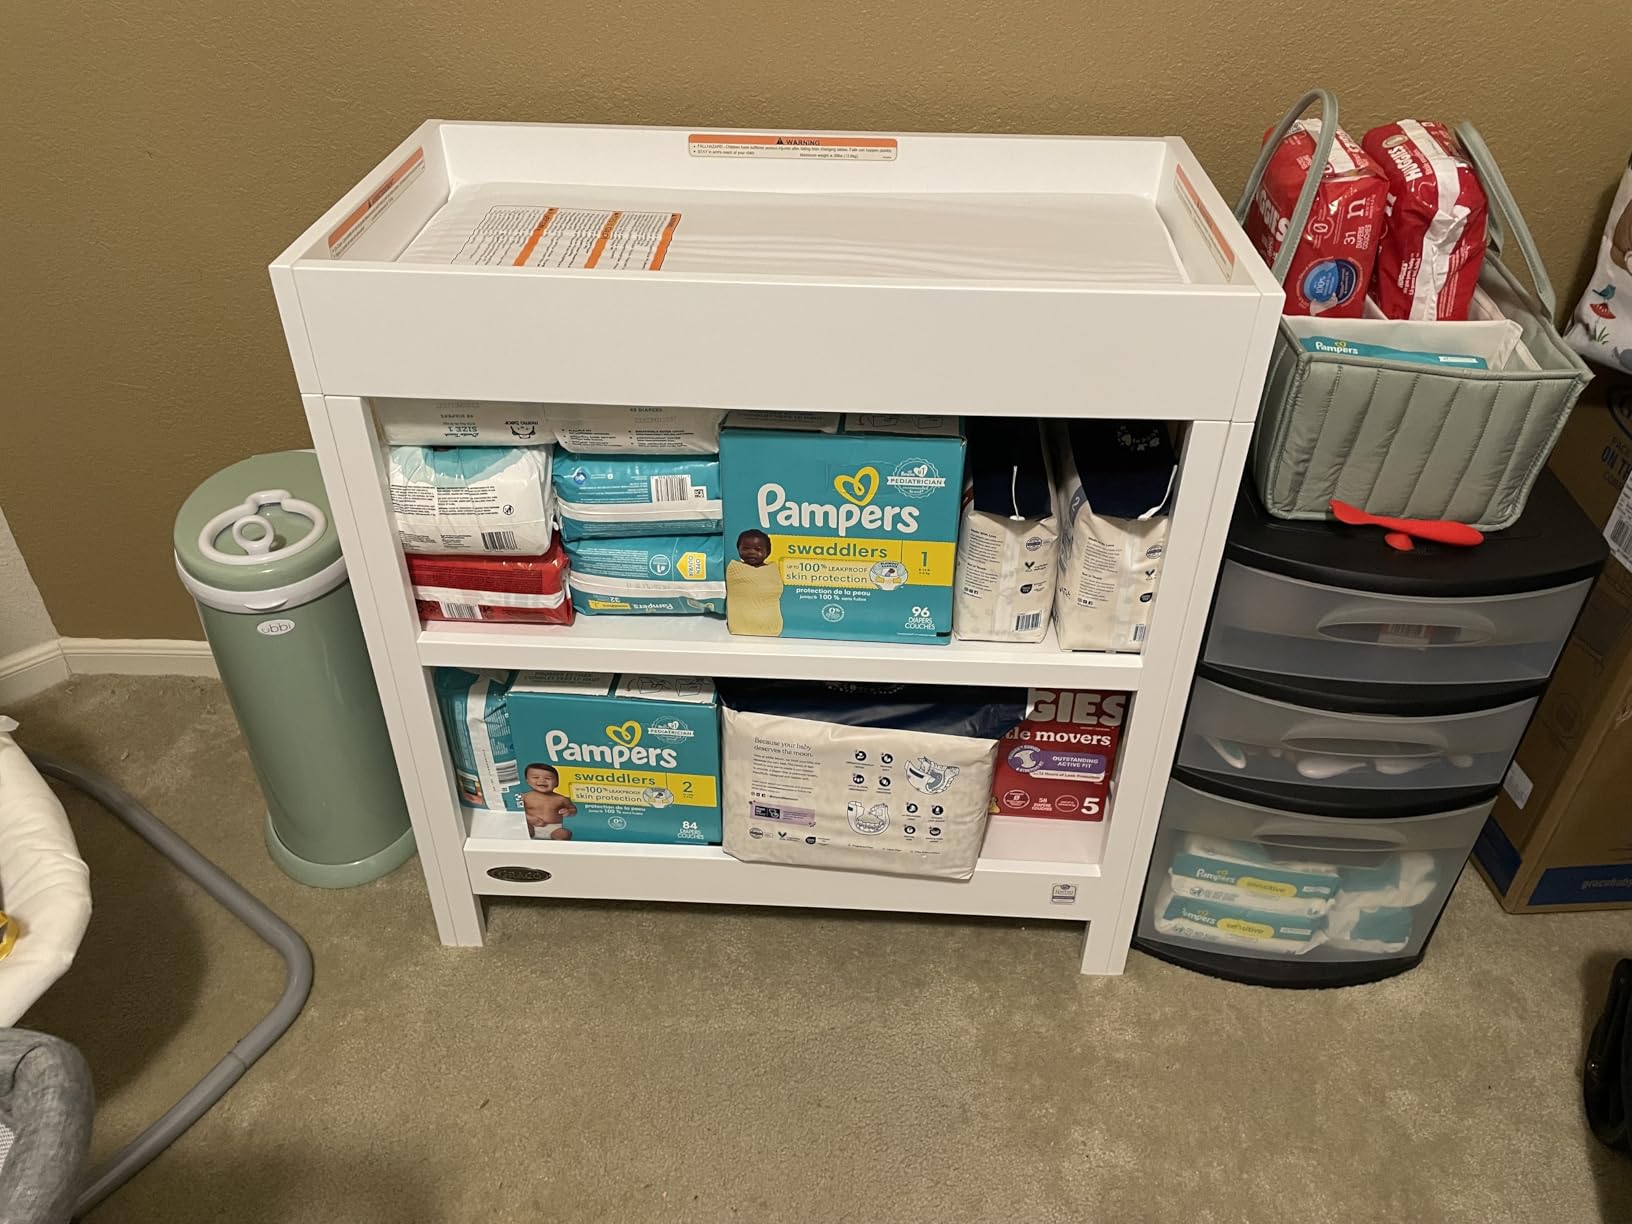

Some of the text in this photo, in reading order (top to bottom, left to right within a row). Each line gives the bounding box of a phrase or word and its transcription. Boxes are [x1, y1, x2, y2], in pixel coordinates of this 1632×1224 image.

[1387, 145, 1423, 182] HUGGIES
[1344, 231, 1356, 245] 31
[1315, 341, 1359, 355] Pampers
[757, 483, 920, 537] Pampers
[788, 543, 888, 558] swaddlers
[921, 552, 928, 567] 1
[800, 562, 827, 572] 100%
[786, 572, 868, 583] skin protection
[844, 588, 851, 596] la
[634, 602, 673, 610] Pampers
[912, 606, 930, 617] 96
[905, 622, 936, 630] COUCHES
[908, 616, 932, 624] DIAPERS
[261, 622, 292, 634] ubbi
[1025, 690, 1127, 726] GIES
[754, 737, 780, 746] Because
[1035, 731, 1112, 746] movers
[546, 730, 678, 769] Pampers
[754, 745, 781, 753] deserves
[1052, 756, 1099, 764] OUTSTANDING
[574, 773, 656, 785] swaddlers
[682, 781, 693, 793] 2
[595, 795, 642, 803] protection
[1081, 797, 1100, 815] 5
[682, 820, 698, 829] 84
[1196, 868, 1236, 884] Pampers
